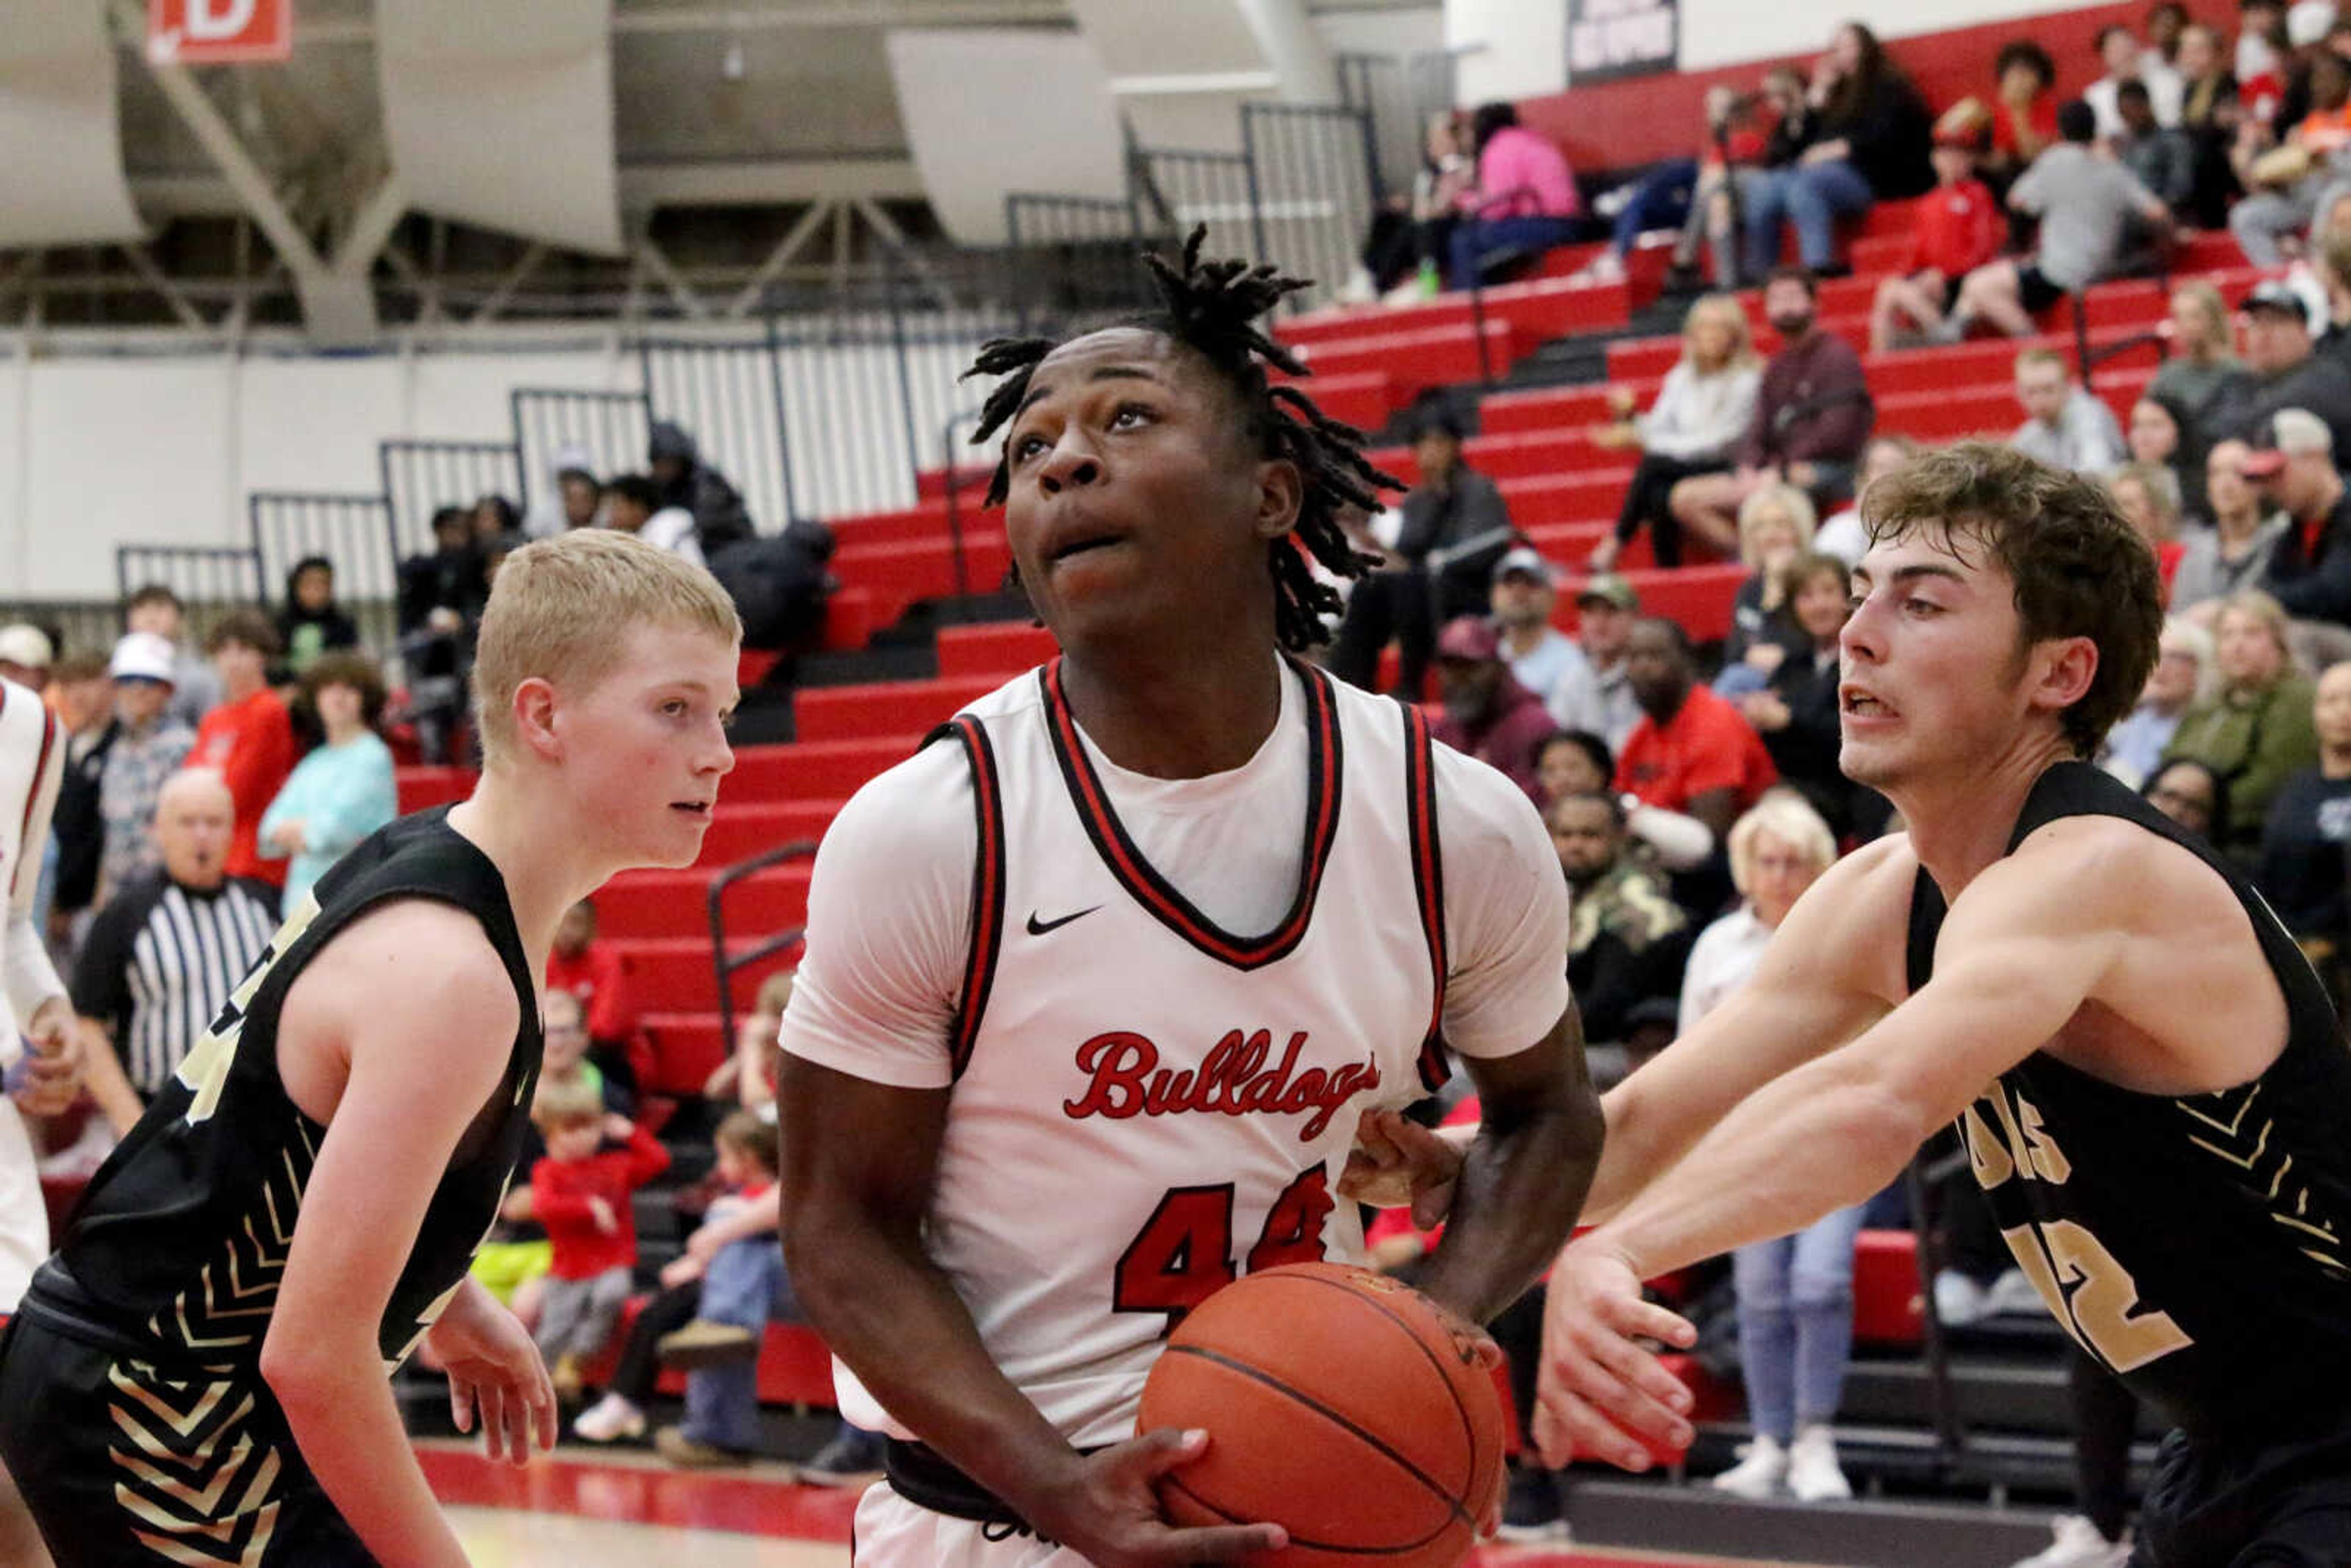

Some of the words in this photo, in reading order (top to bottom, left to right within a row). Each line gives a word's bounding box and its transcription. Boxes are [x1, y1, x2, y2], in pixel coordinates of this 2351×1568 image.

[1063, 1027, 1381, 1142] Bulldogs
[1112, 1159, 1336, 1343] 44
[1999, 1218, 2197, 1376] 12
